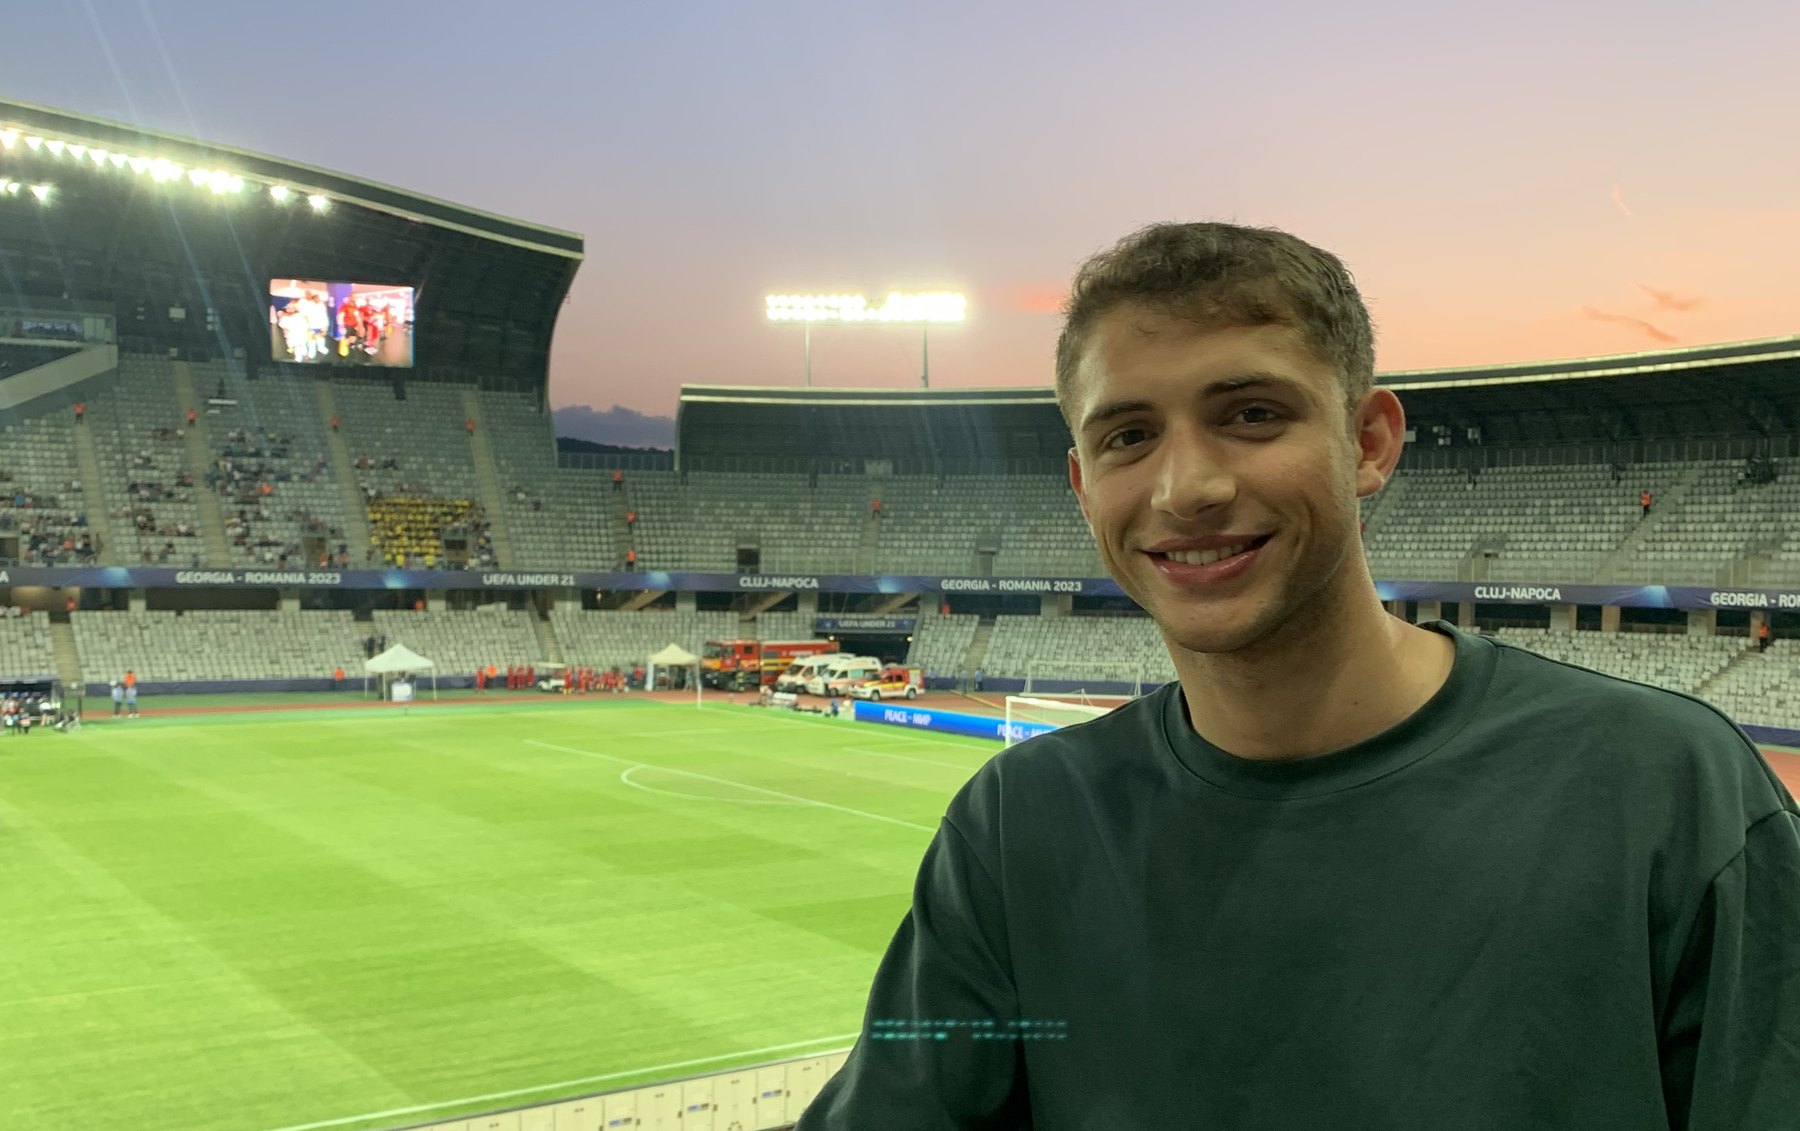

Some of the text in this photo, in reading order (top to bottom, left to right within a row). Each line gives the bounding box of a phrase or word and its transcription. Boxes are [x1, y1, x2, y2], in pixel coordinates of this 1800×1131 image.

[175, 571, 235, 584] GEORGIA
[245, 571, 306, 584] ROMANIA
[308, 572, 341, 585] 2023
[483, 573, 575, 586] UEFA UNDER 21
[739, 575, 819, 589] CLUJ-NAPOCA
[940, 579, 990, 591] GEORGIA
[999, 579, 1052, 591] ROMANIA
[1054, 580, 1082, 592] 2023
[1474, 586, 1562, 601] CLUJ-NAPOCA
[1710, 591, 1769, 607] GEORGIA
